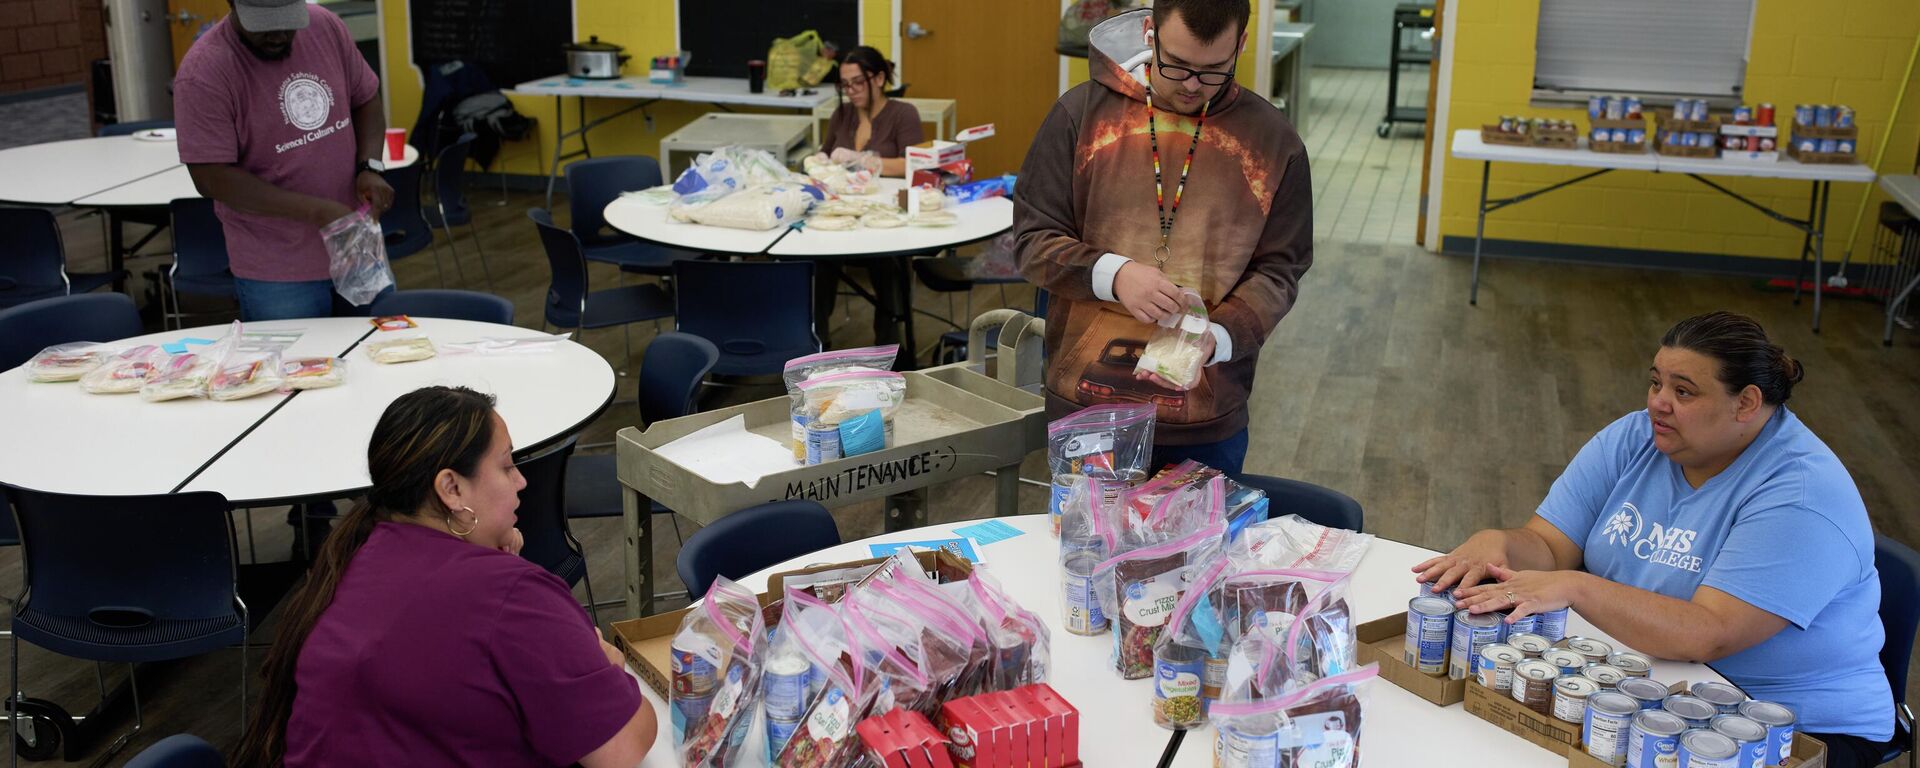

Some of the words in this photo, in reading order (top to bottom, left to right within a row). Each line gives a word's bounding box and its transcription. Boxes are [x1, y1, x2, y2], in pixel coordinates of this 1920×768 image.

[291, 72, 319, 81] Sahnish
[320, 79, 335, 107] College
[275, 126, 335, 154] Science/Culture
[1648, 522, 1697, 554] NHS
[1139, 606, 1160, 617] Crust
[1161, 603, 1176, 613] Mix
